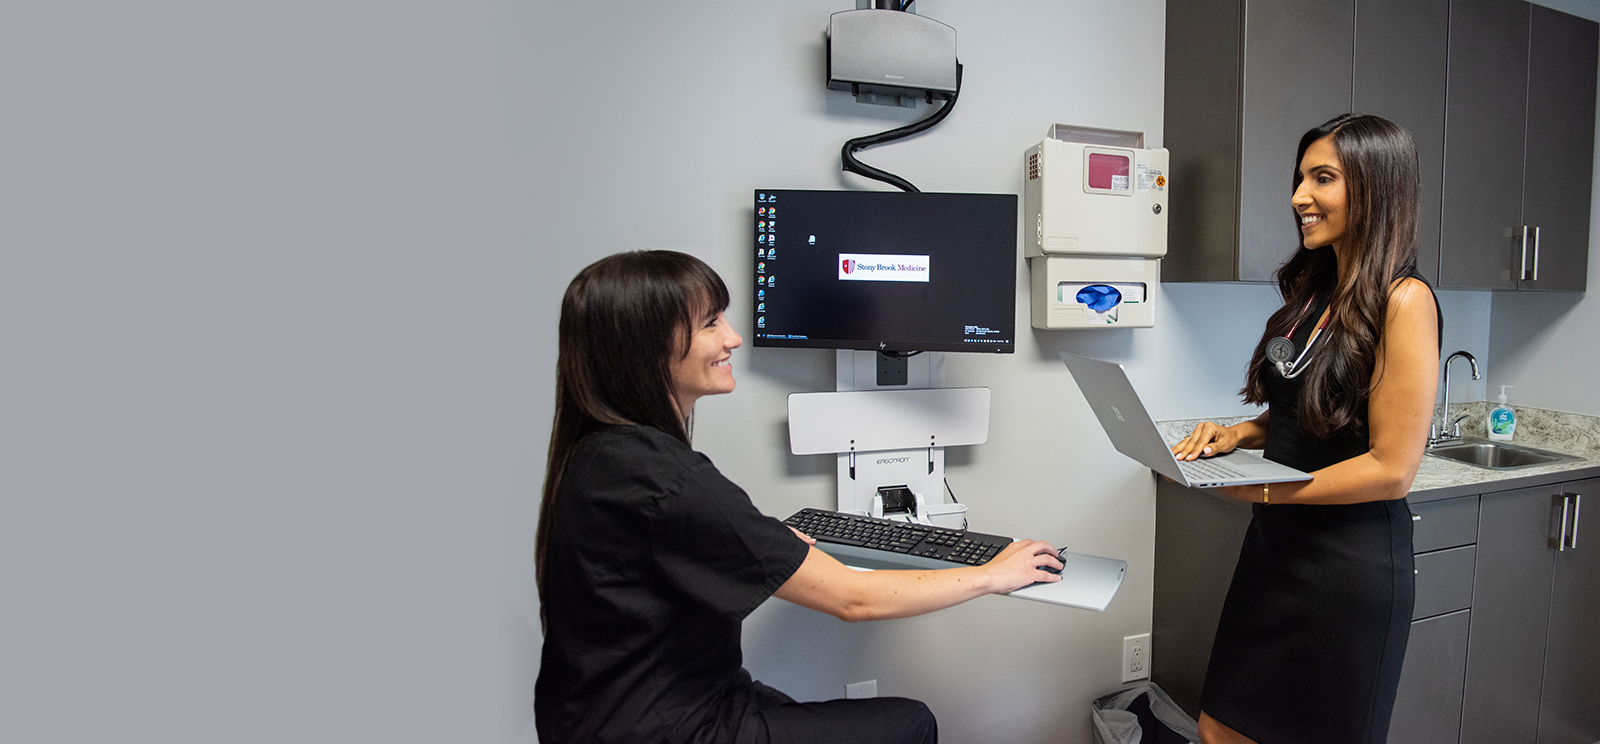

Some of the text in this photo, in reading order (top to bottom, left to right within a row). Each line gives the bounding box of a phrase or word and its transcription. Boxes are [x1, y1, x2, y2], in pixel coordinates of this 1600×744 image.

[857, 263, 926, 272] Stony Brook Medicine
[876, 457, 910, 465] ERGOTRON
